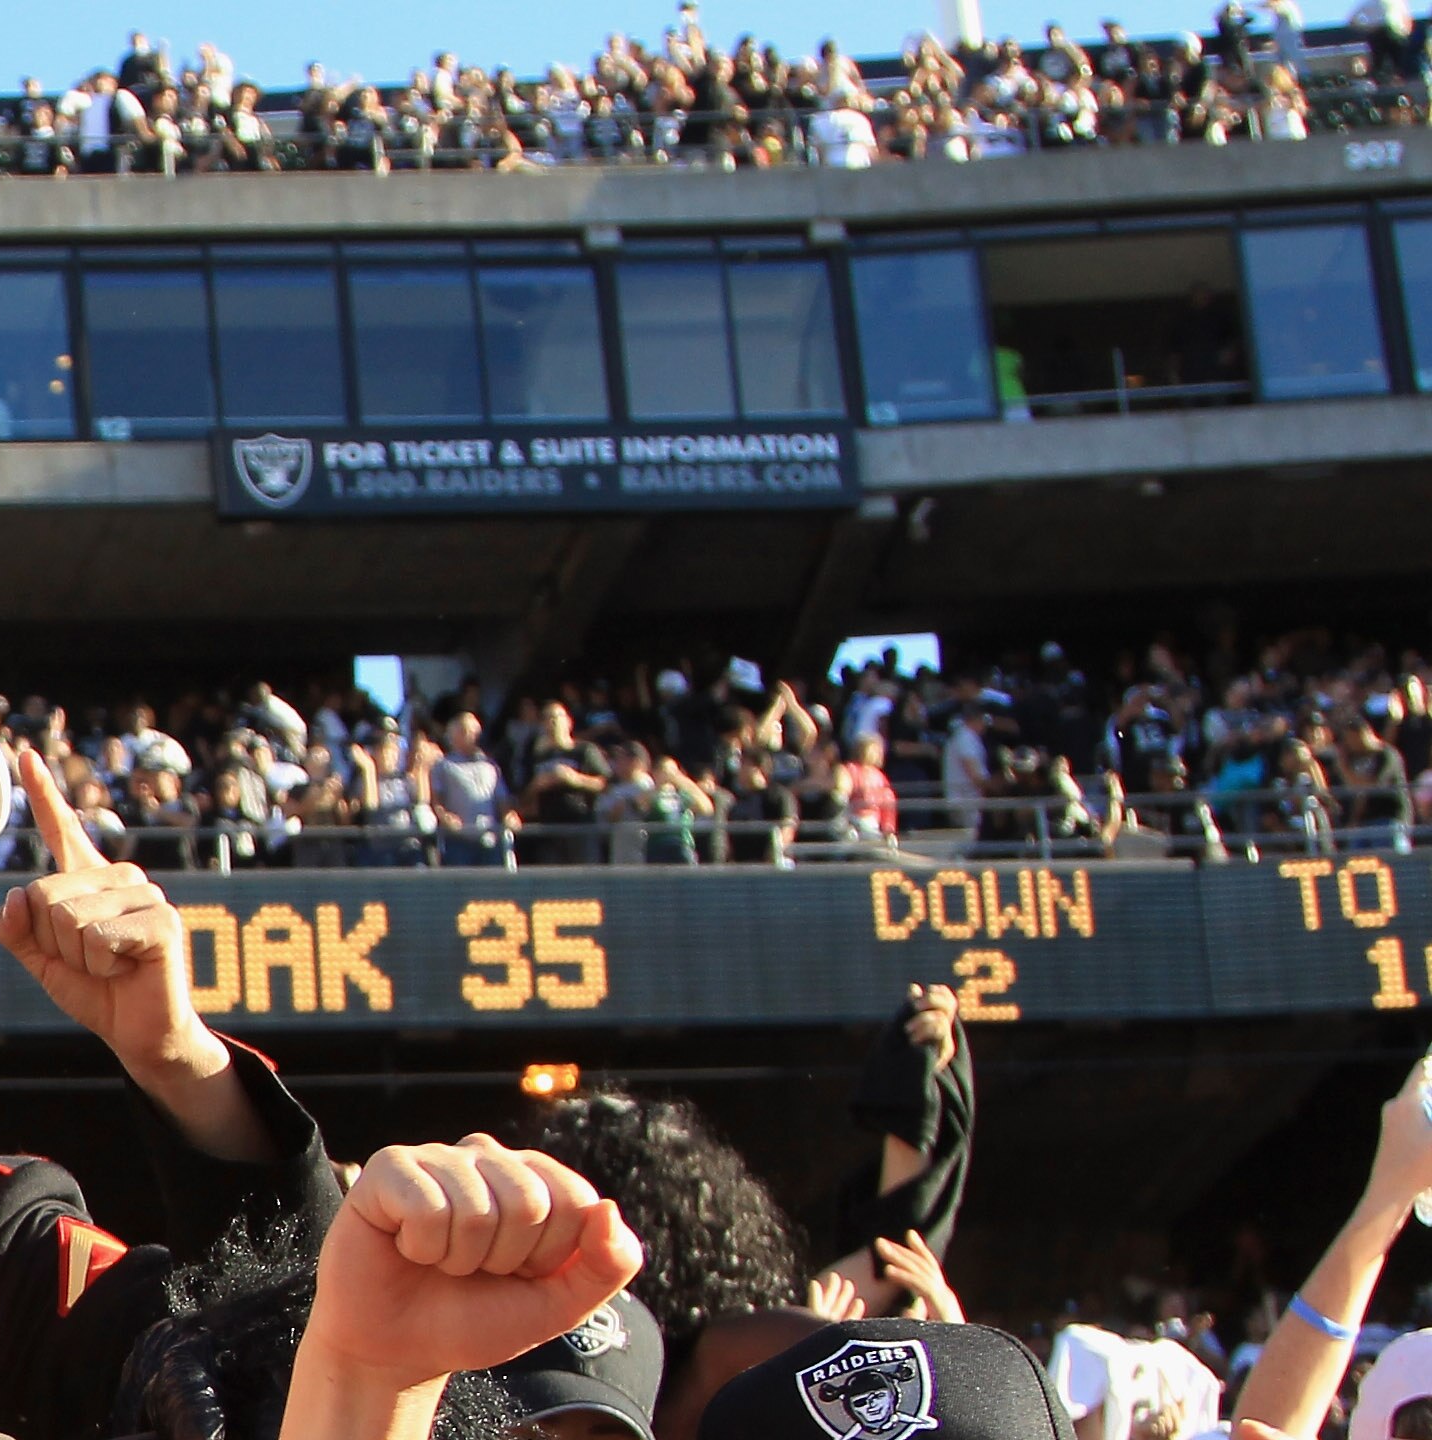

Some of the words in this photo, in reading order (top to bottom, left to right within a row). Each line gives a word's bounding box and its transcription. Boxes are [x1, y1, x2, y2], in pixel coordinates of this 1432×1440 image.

[323, 441, 386, 469] FOR
[390, 439, 493, 467] TICKET
[499, 438, 526, 466] &
[530, 436, 618, 467] SUITE
[622, 432, 841, 464] INFORMATION
[871, 868, 1094, 941] DOWN
[1279, 855, 1398, 932] TO
[456, 899, 608, 1010] 35
[953, 948, 1022, 1022] 2
[1366, 935, 1432, 1011] 1
[812, 1347, 908, 1382] RAIDERS
